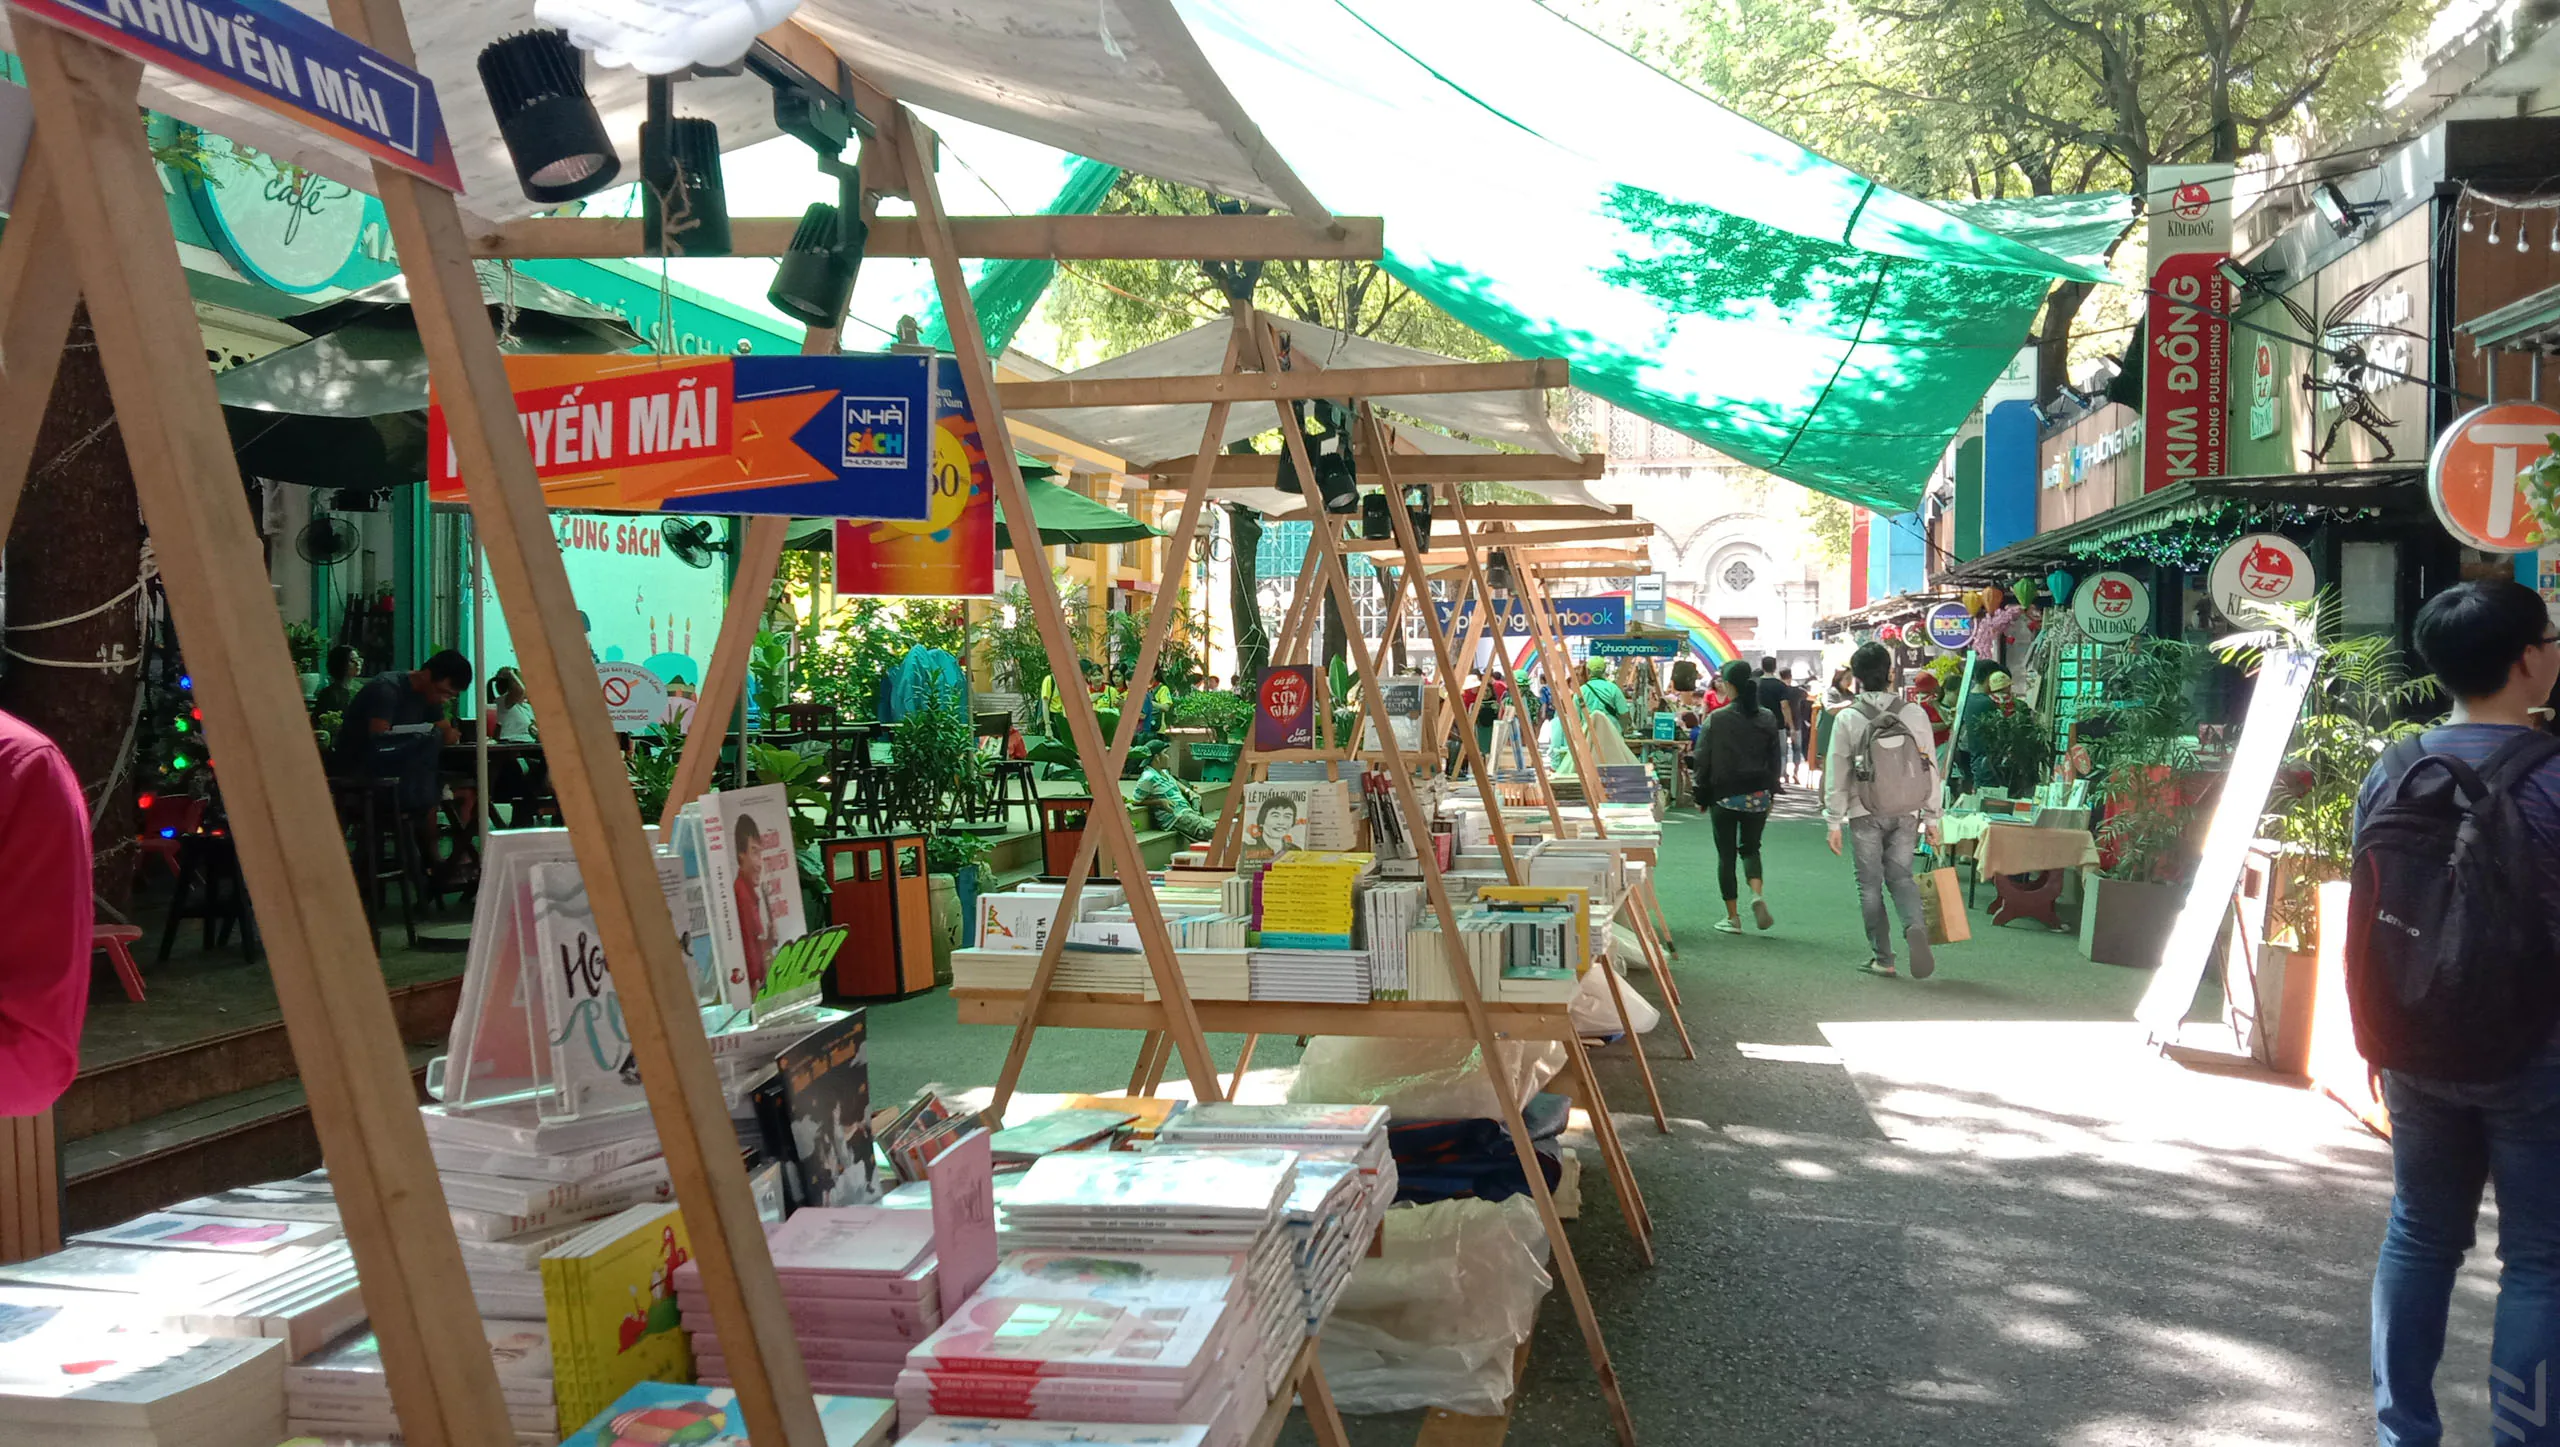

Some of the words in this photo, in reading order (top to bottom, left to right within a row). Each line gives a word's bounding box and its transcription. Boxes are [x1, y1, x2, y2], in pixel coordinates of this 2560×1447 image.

[304, 56, 392, 138] MÃI
[2167, 220, 2186, 237] KIM
[2208, 323, 2222, 403] PUBLISHING
[627, 376, 718, 456] MÃI
[848, 404, 903, 425] NHÀ
[2208, 408, 2220, 447] DONG
[847, 427, 903, 455] SÁCH
[2166, 406, 2198, 477] KIM
[2208, 451, 2220, 476] KIM
[615, 517, 661, 558] SÁCH
[1934, 618, 1970, 629] BOOK
[2088, 617, 2108, 634] KIM
